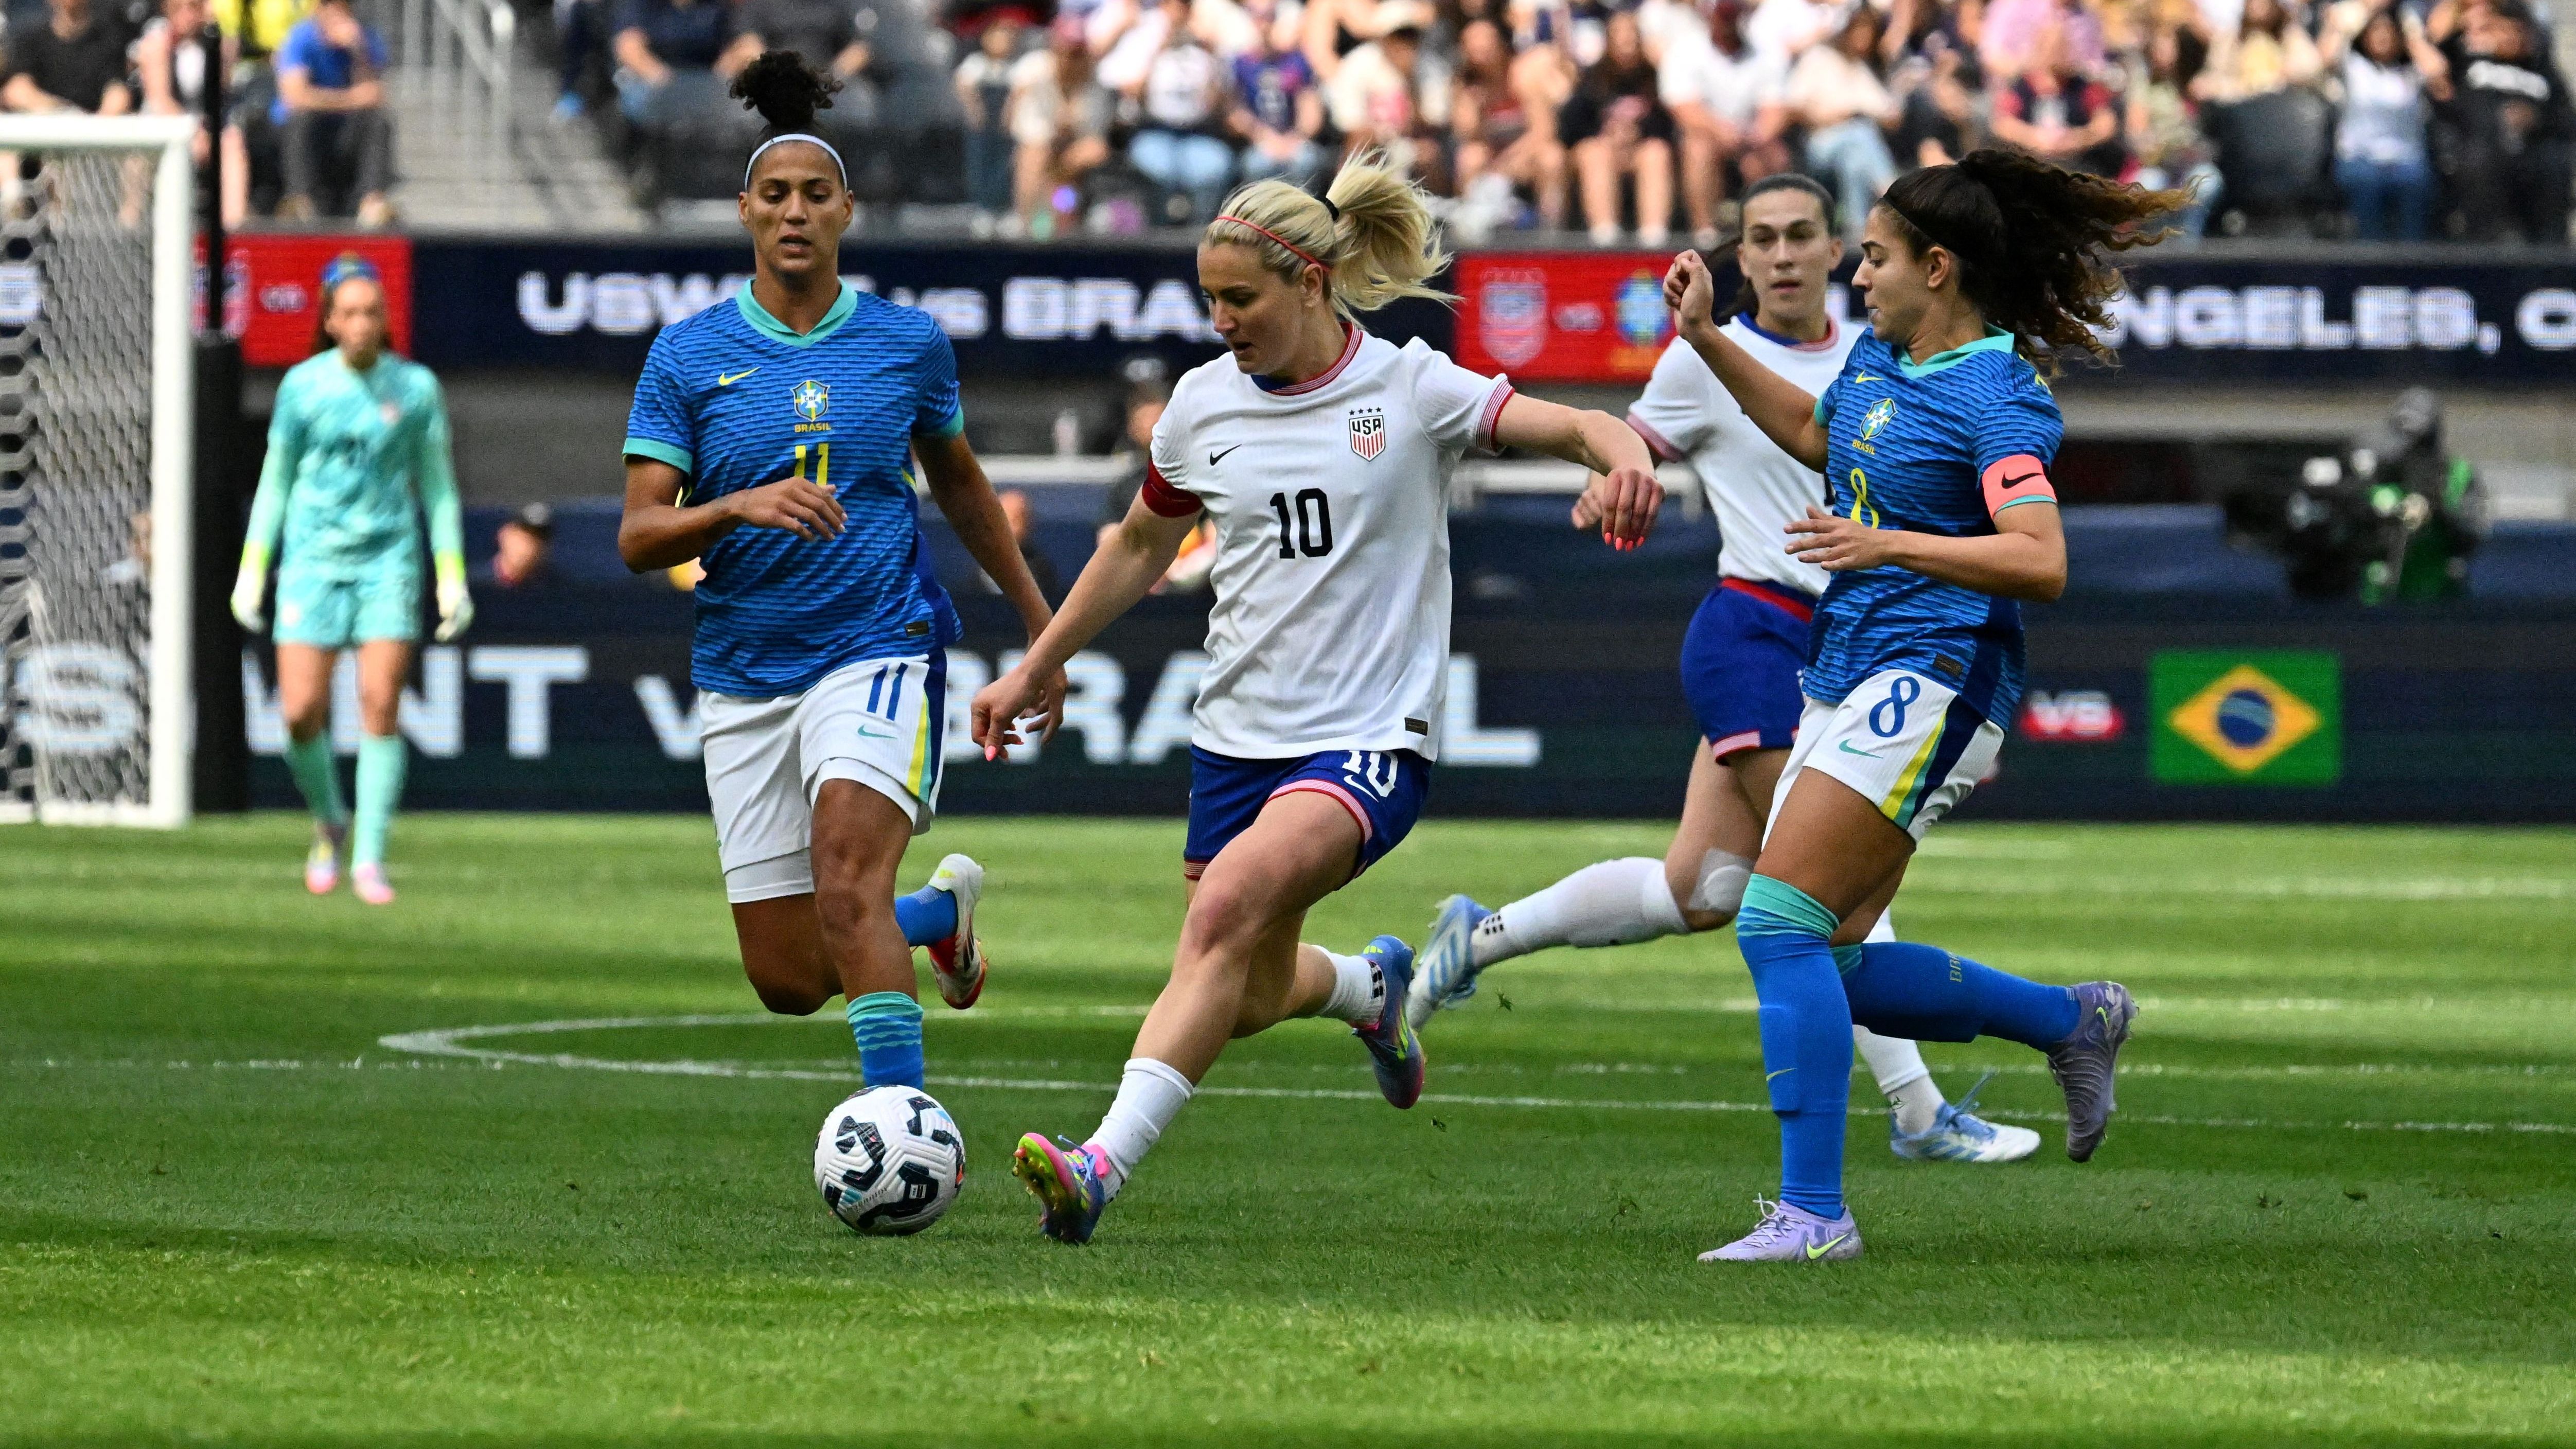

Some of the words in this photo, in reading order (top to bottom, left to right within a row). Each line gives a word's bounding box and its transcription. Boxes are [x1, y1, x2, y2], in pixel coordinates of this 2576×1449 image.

[1002, 276, 1223, 342] BRA
[2069, 286, 2501, 354] NGELES,
[794, 422, 832, 433] BRASIL
[1352, 419, 1381, 435] USA
[1852, 439, 1875, 455] BRASIL
[795, 443, 829, 486] 11
[1269, 488, 1333, 559] 10
[1850, 468, 1879, 529] 8
[867, 662, 908, 721] 11
[944, 647, 1539, 767] BRAL
[1868, 676, 1920, 737] 8
[1342, 750, 1398, 797] 10
